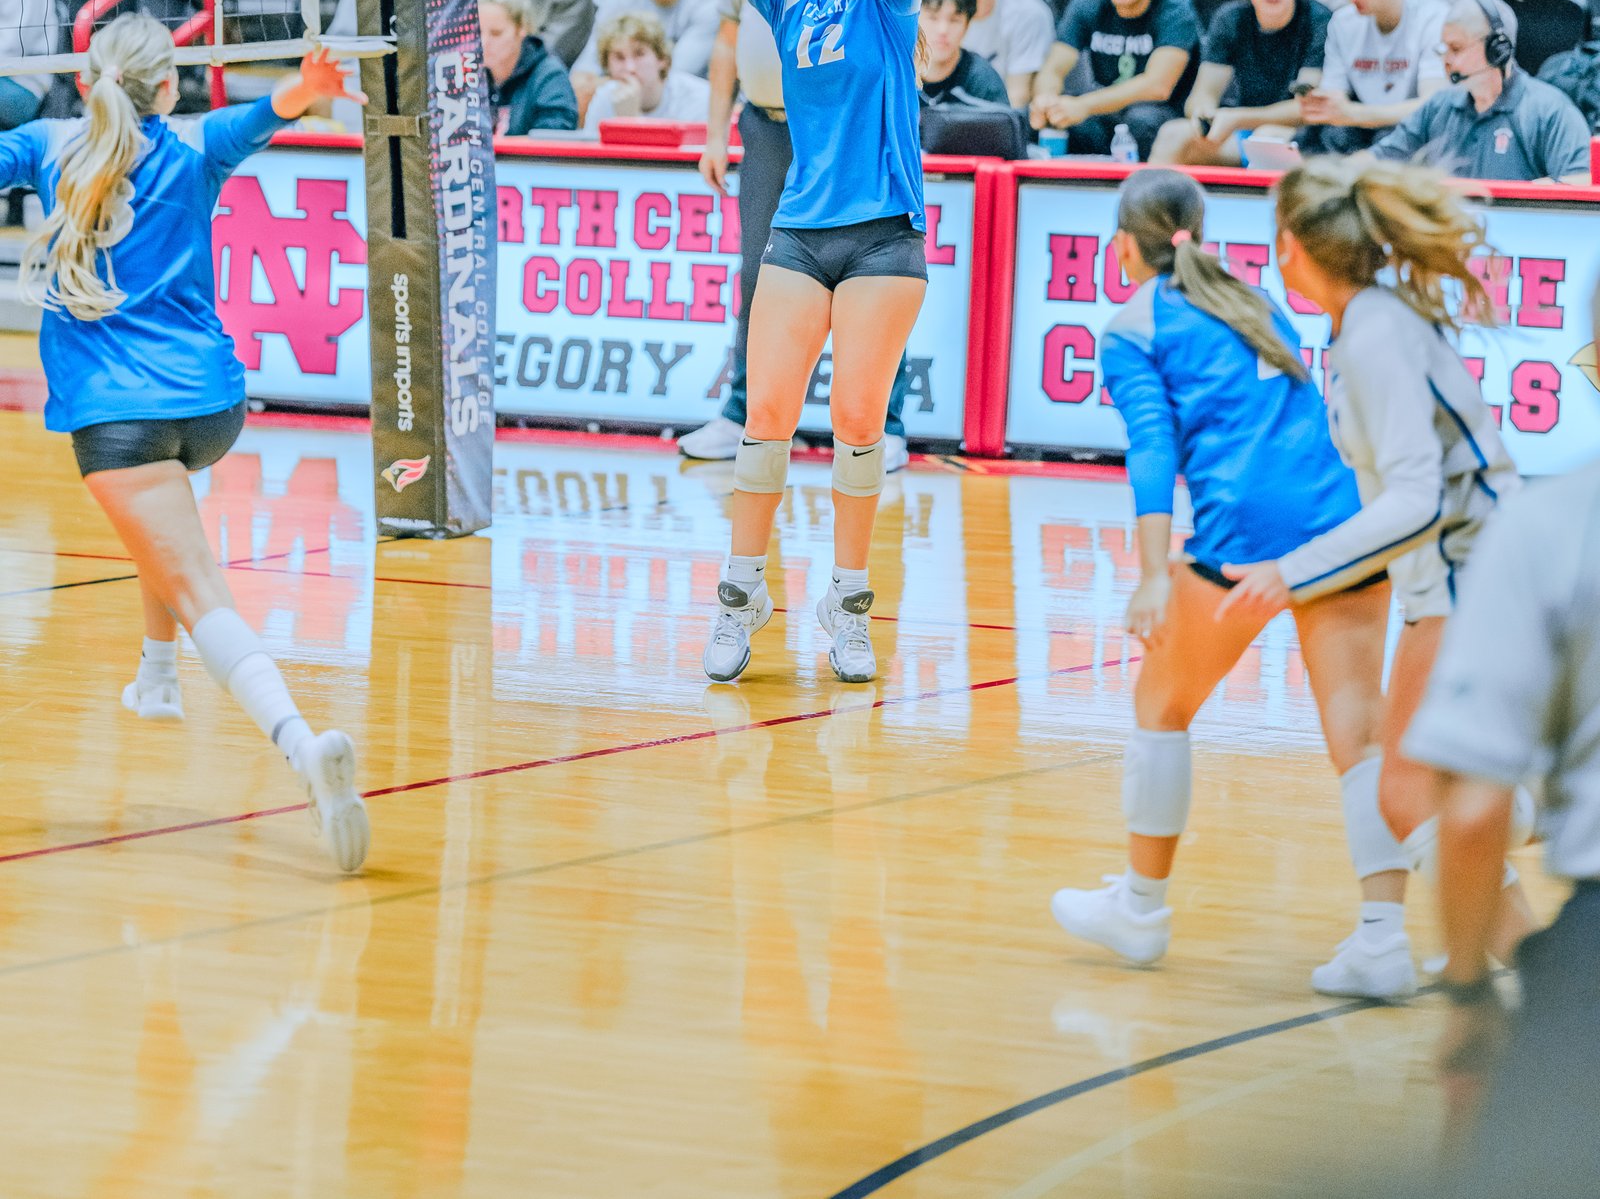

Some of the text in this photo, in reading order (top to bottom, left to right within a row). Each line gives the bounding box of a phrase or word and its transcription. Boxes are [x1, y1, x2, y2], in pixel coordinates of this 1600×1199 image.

[796, 23, 845, 69] 12
[463, 52, 482, 147] NORTH
[434, 52, 479, 437] CARDINALS
[470, 158, 488, 287] CENTRAL
[497, 185, 618, 248] RTH
[522, 255, 741, 323] COLLE
[390, 272, 416, 432] sports imports
